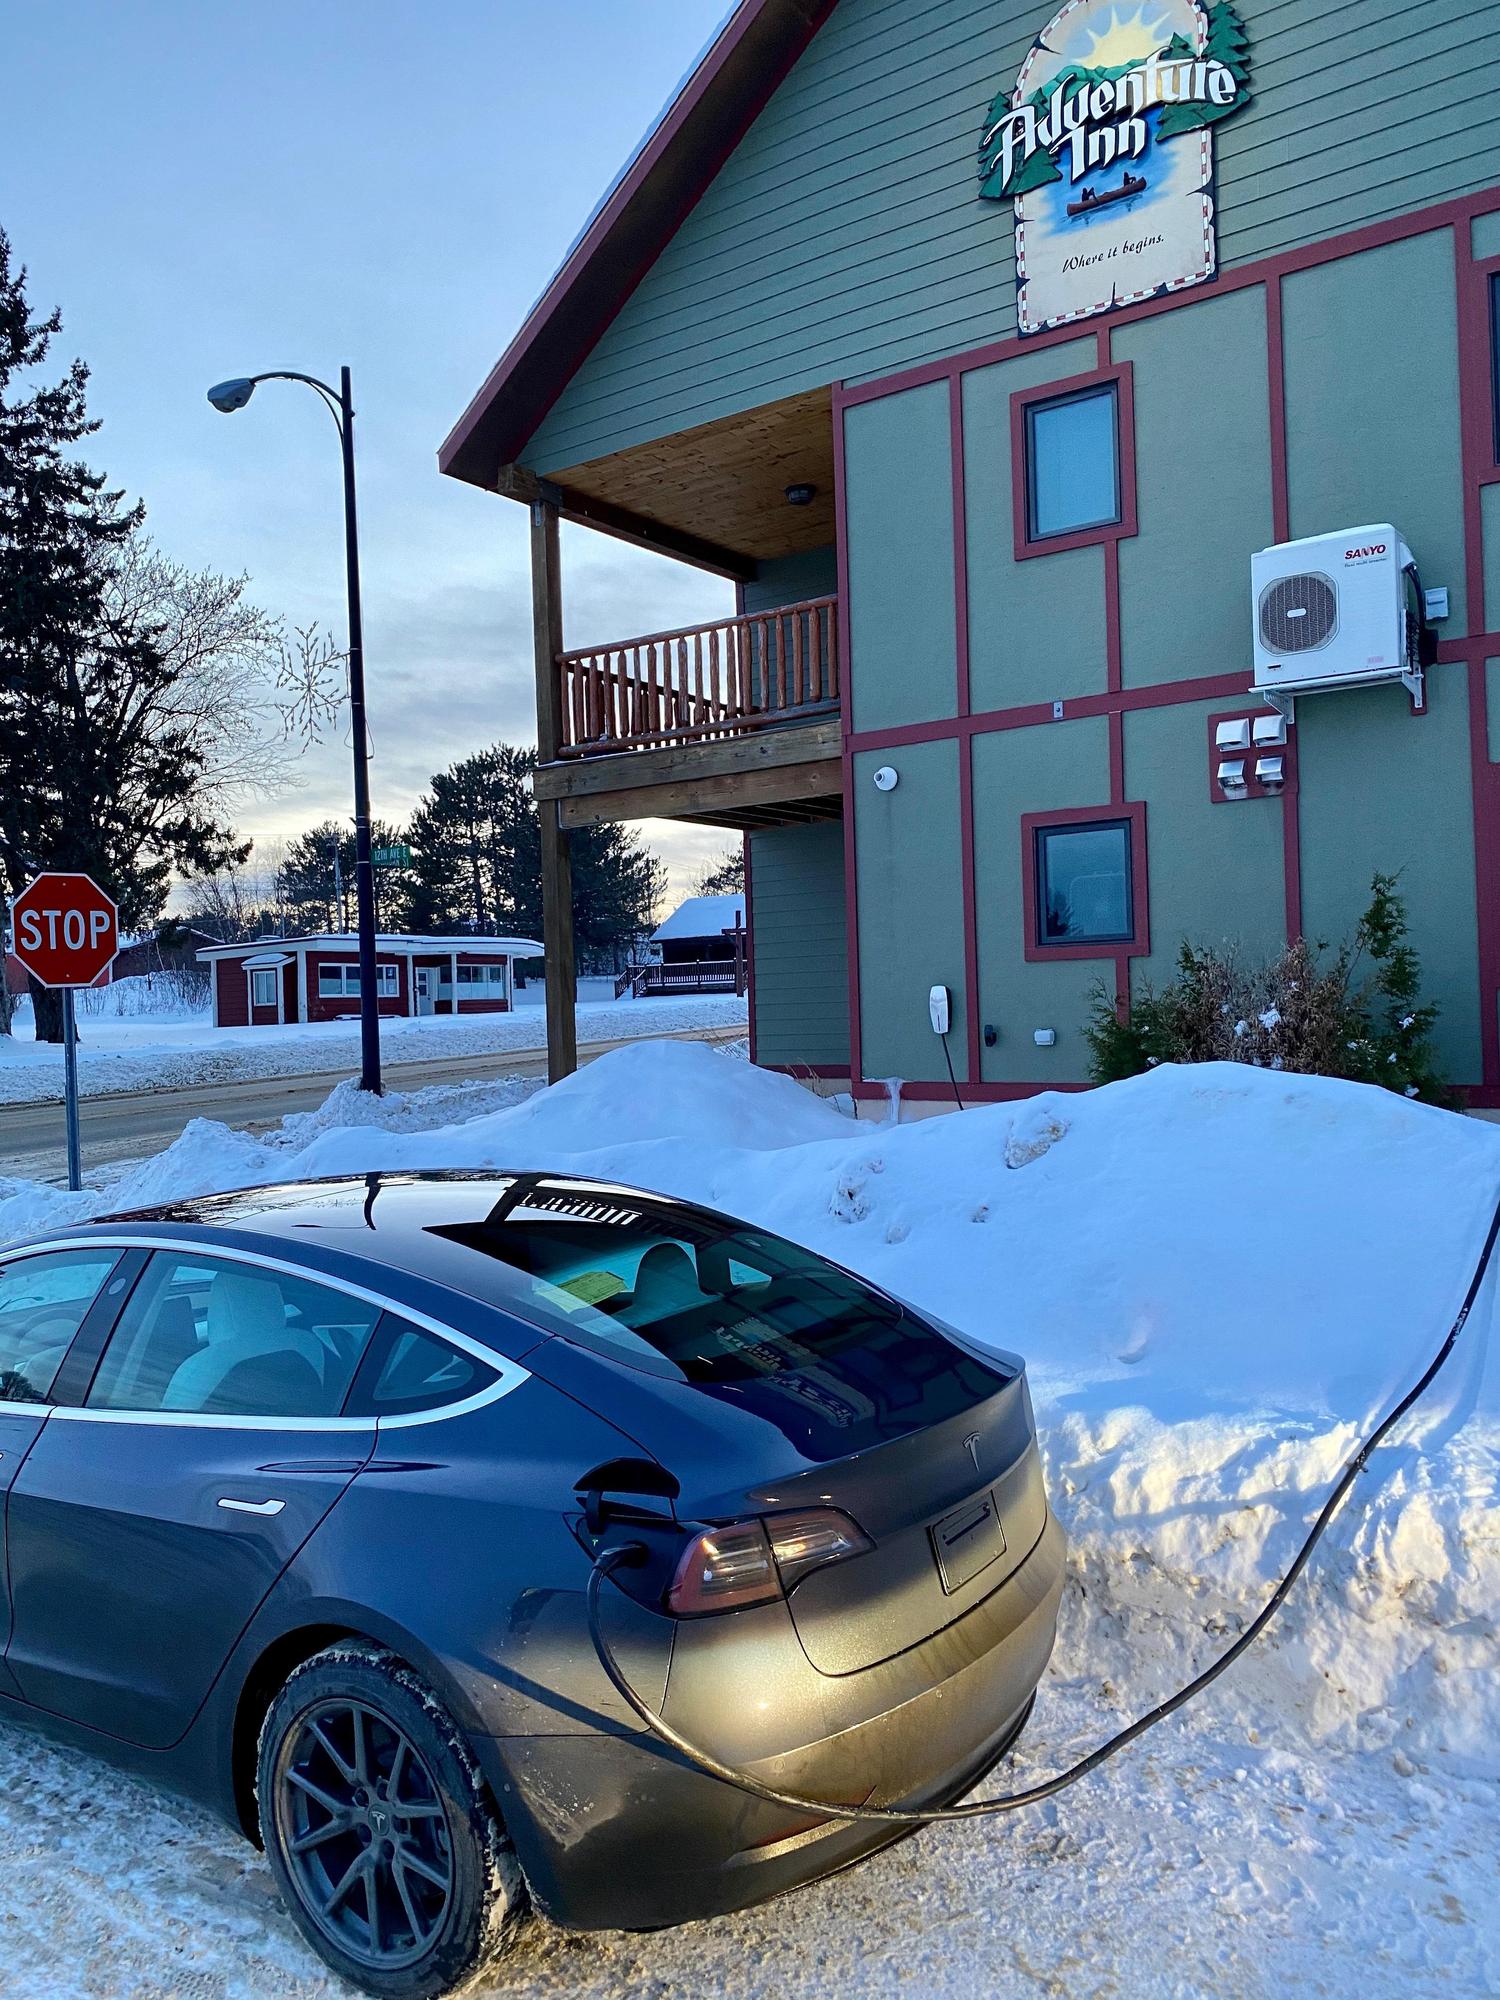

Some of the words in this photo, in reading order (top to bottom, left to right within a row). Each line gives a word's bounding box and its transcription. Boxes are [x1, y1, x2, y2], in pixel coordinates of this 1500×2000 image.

[983, 47, 1237, 190] Adventure
[1049, 118, 1146, 181] Inn
[1062, 254, 1104, 273] Where
[1107, 246, 1118, 259] it
[1122, 234, 1164, 254] begins.
[1344, 544, 1386, 560] SANYO
[374, 849, 388, 861] 12TH
[389, 847, 400, 860] AVE
[402, 846, 407, 858] E
[20, 909, 111, 951] STOP
